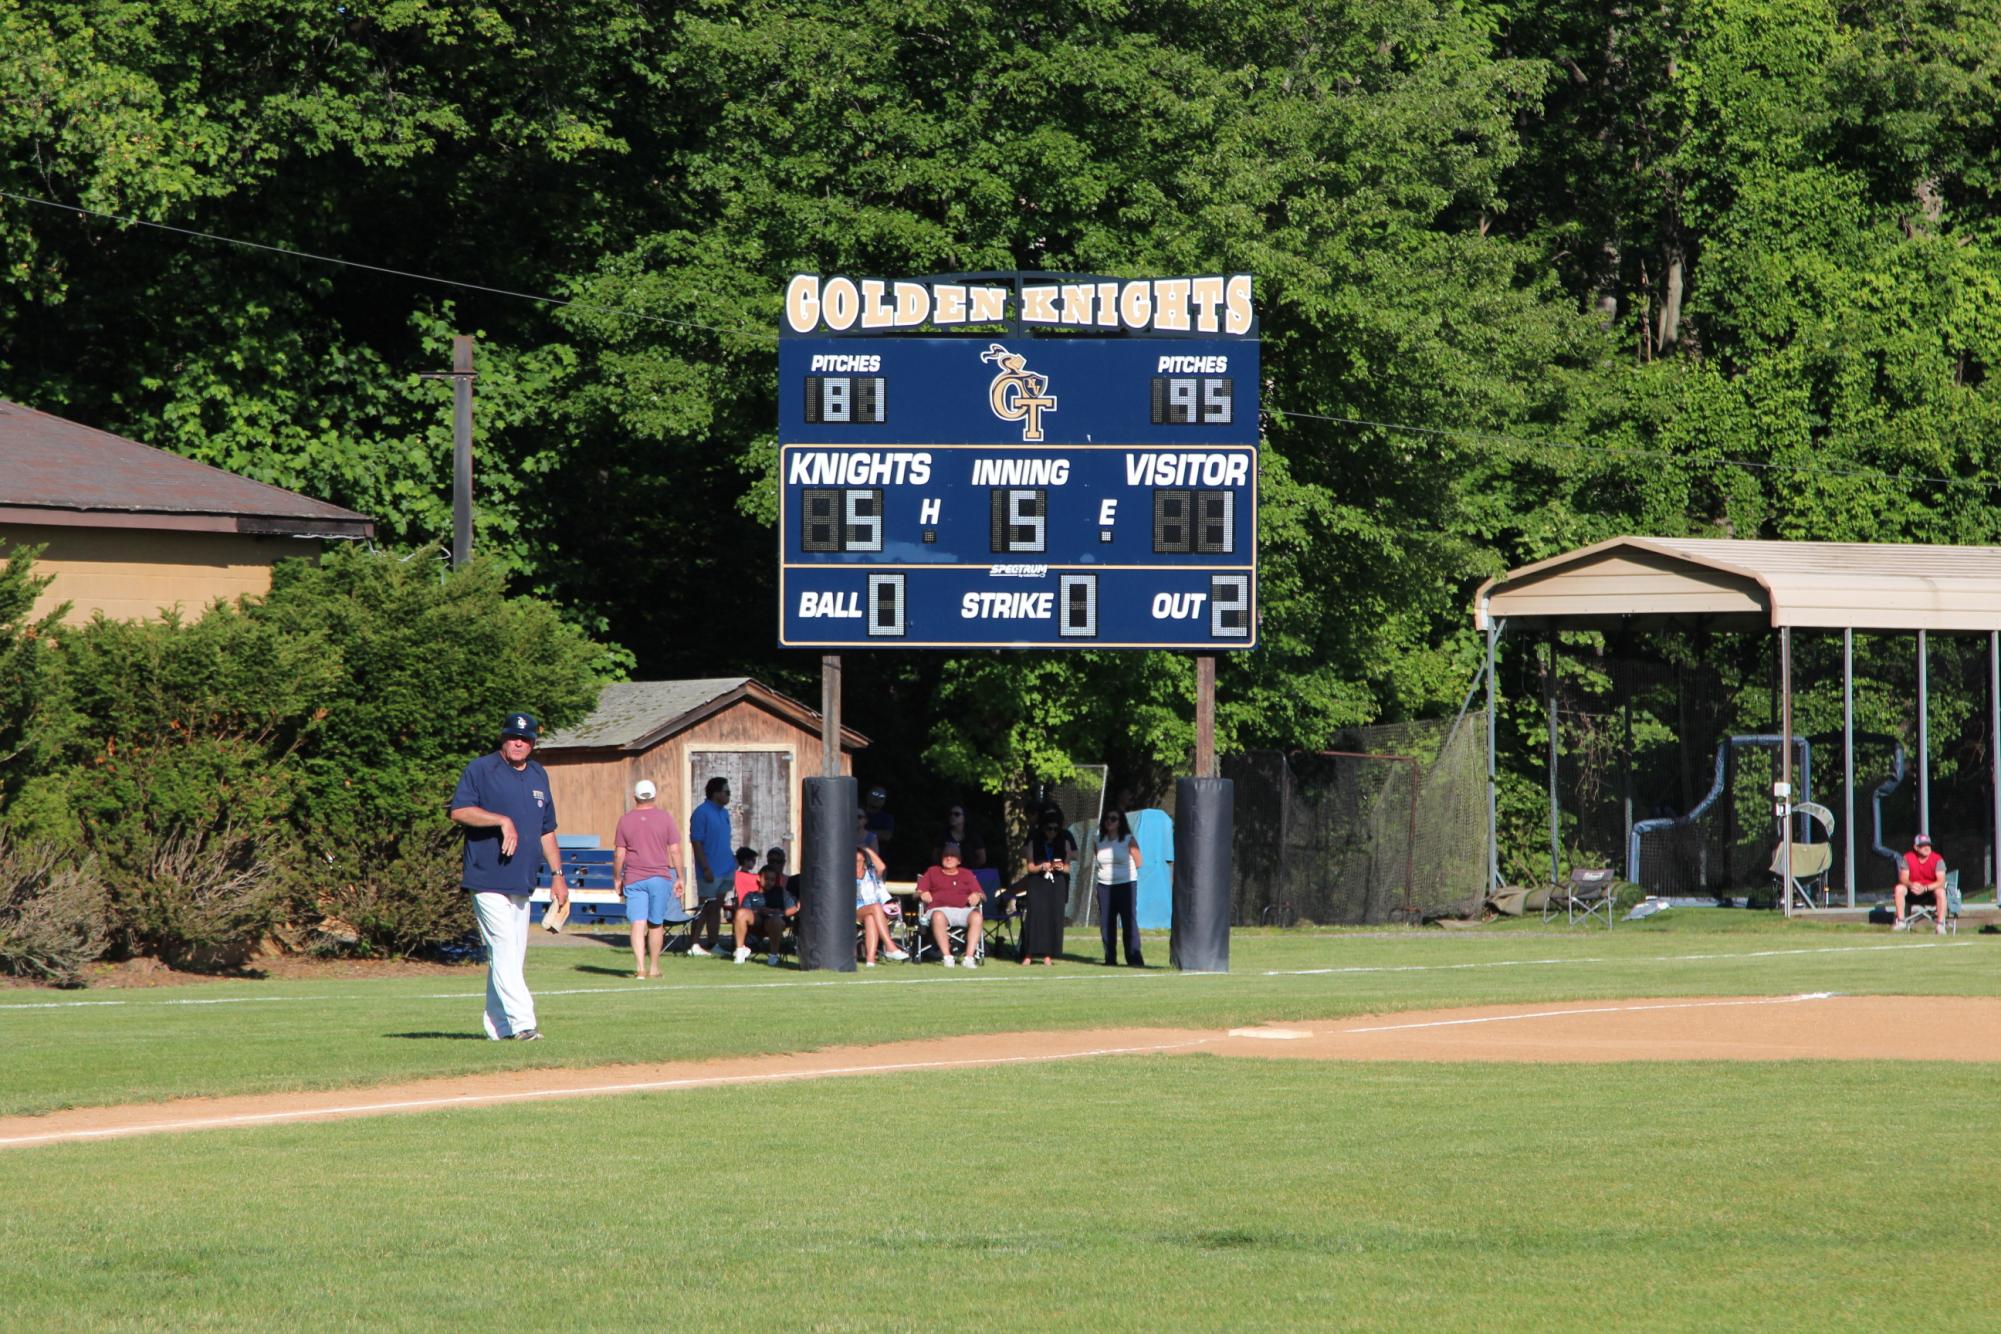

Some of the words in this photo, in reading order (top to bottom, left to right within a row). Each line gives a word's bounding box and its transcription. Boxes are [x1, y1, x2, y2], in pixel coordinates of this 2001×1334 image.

[786, 275, 1006, 332] GOLDEN
[1021, 275, 1253, 336] KNIGHTS
[811, 354, 881, 372] PITCHES
[1158, 356, 1228, 373] PITCHES
[1170, 378, 1232, 422] 95
[789, 453, 932, 485] KNIGHTS
[972, 459, 1070, 486] INNING
[1126, 453, 1249, 486] VISITOR
[846, 490, 882, 551] 5
[920, 498, 941, 524] H
[1009, 490, 1045, 551] 5
[1099, 499, 1118, 525] E
[990, 564, 1047, 574] SPECTRUM
[799, 592, 862, 618] BALL
[868, 574, 904, 636] 0
[961, 592, 1054, 619] STRIKE
[1060, 575, 1096, 636] 0
[1151, 593, 1206, 619] OUT
[1212, 575, 1247, 636] 2
